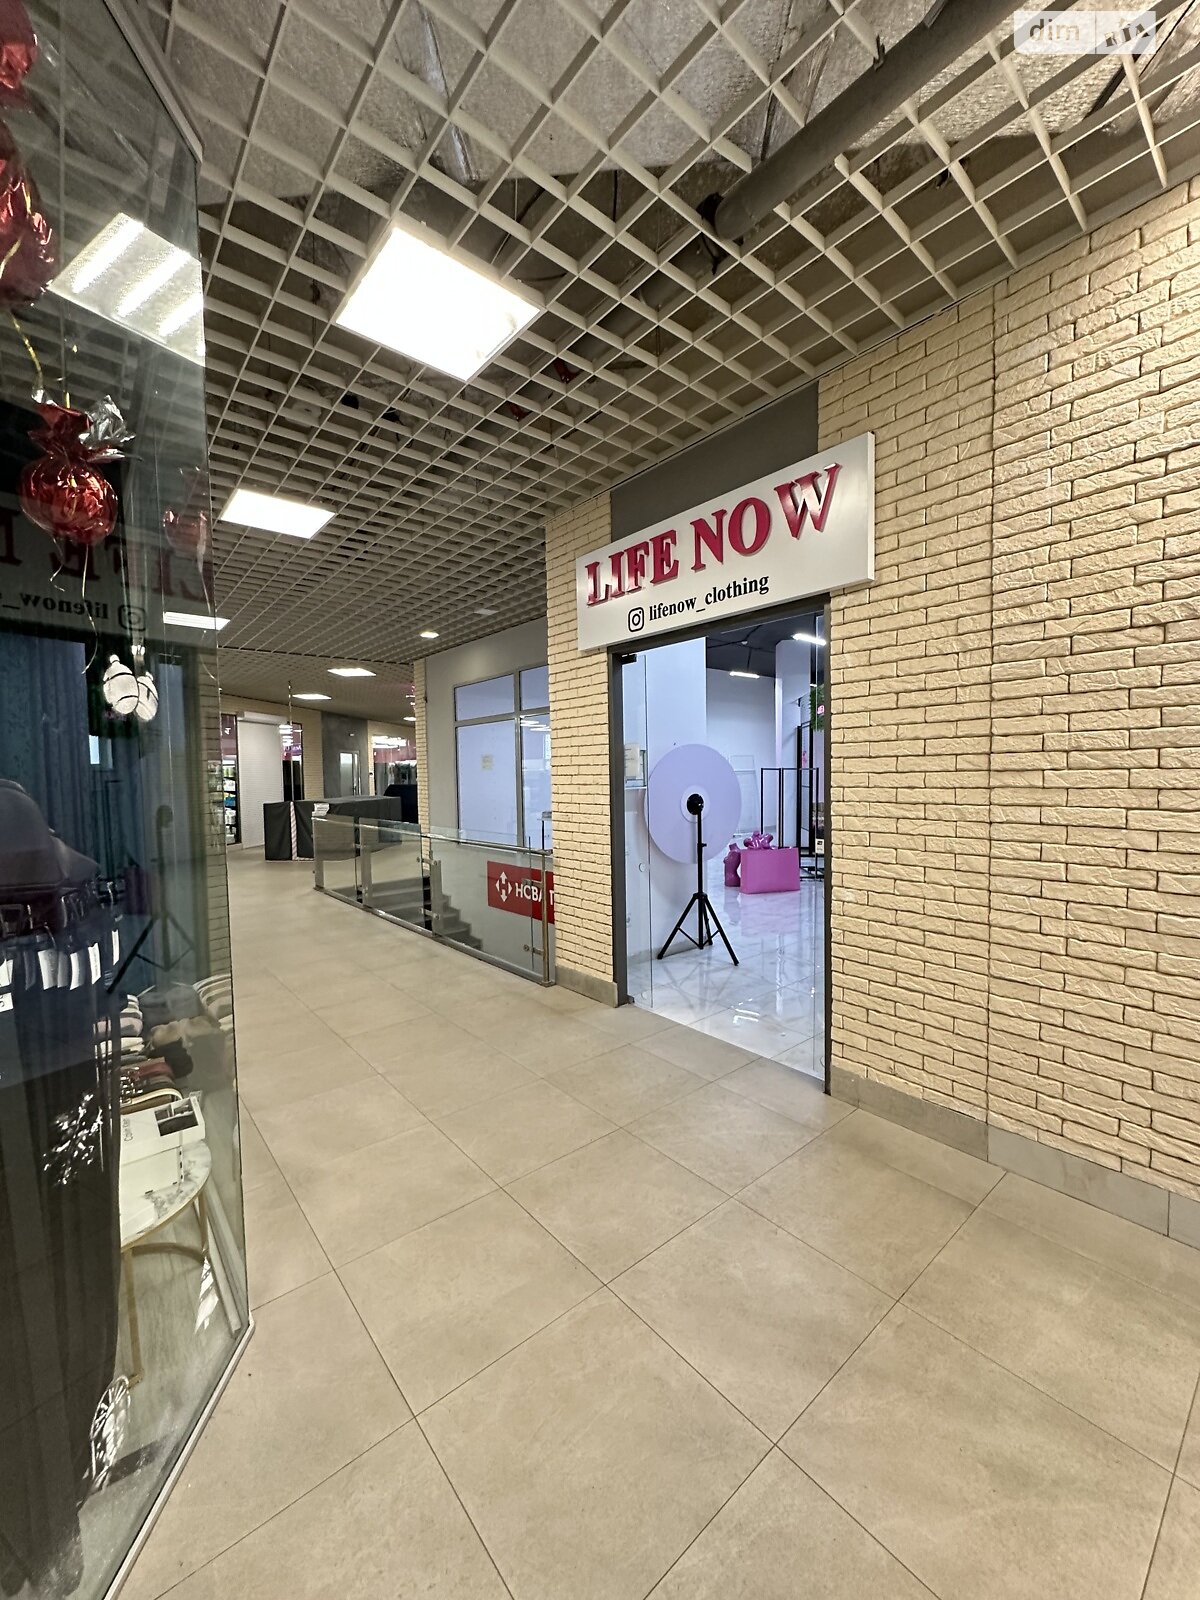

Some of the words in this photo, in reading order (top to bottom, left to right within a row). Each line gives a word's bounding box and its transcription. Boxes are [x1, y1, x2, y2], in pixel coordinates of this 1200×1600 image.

[585, 529, 679, 607] LIFE
[690, 463, 842, 573] NOW
[649, 576, 770, 621] lifenow_clothing
